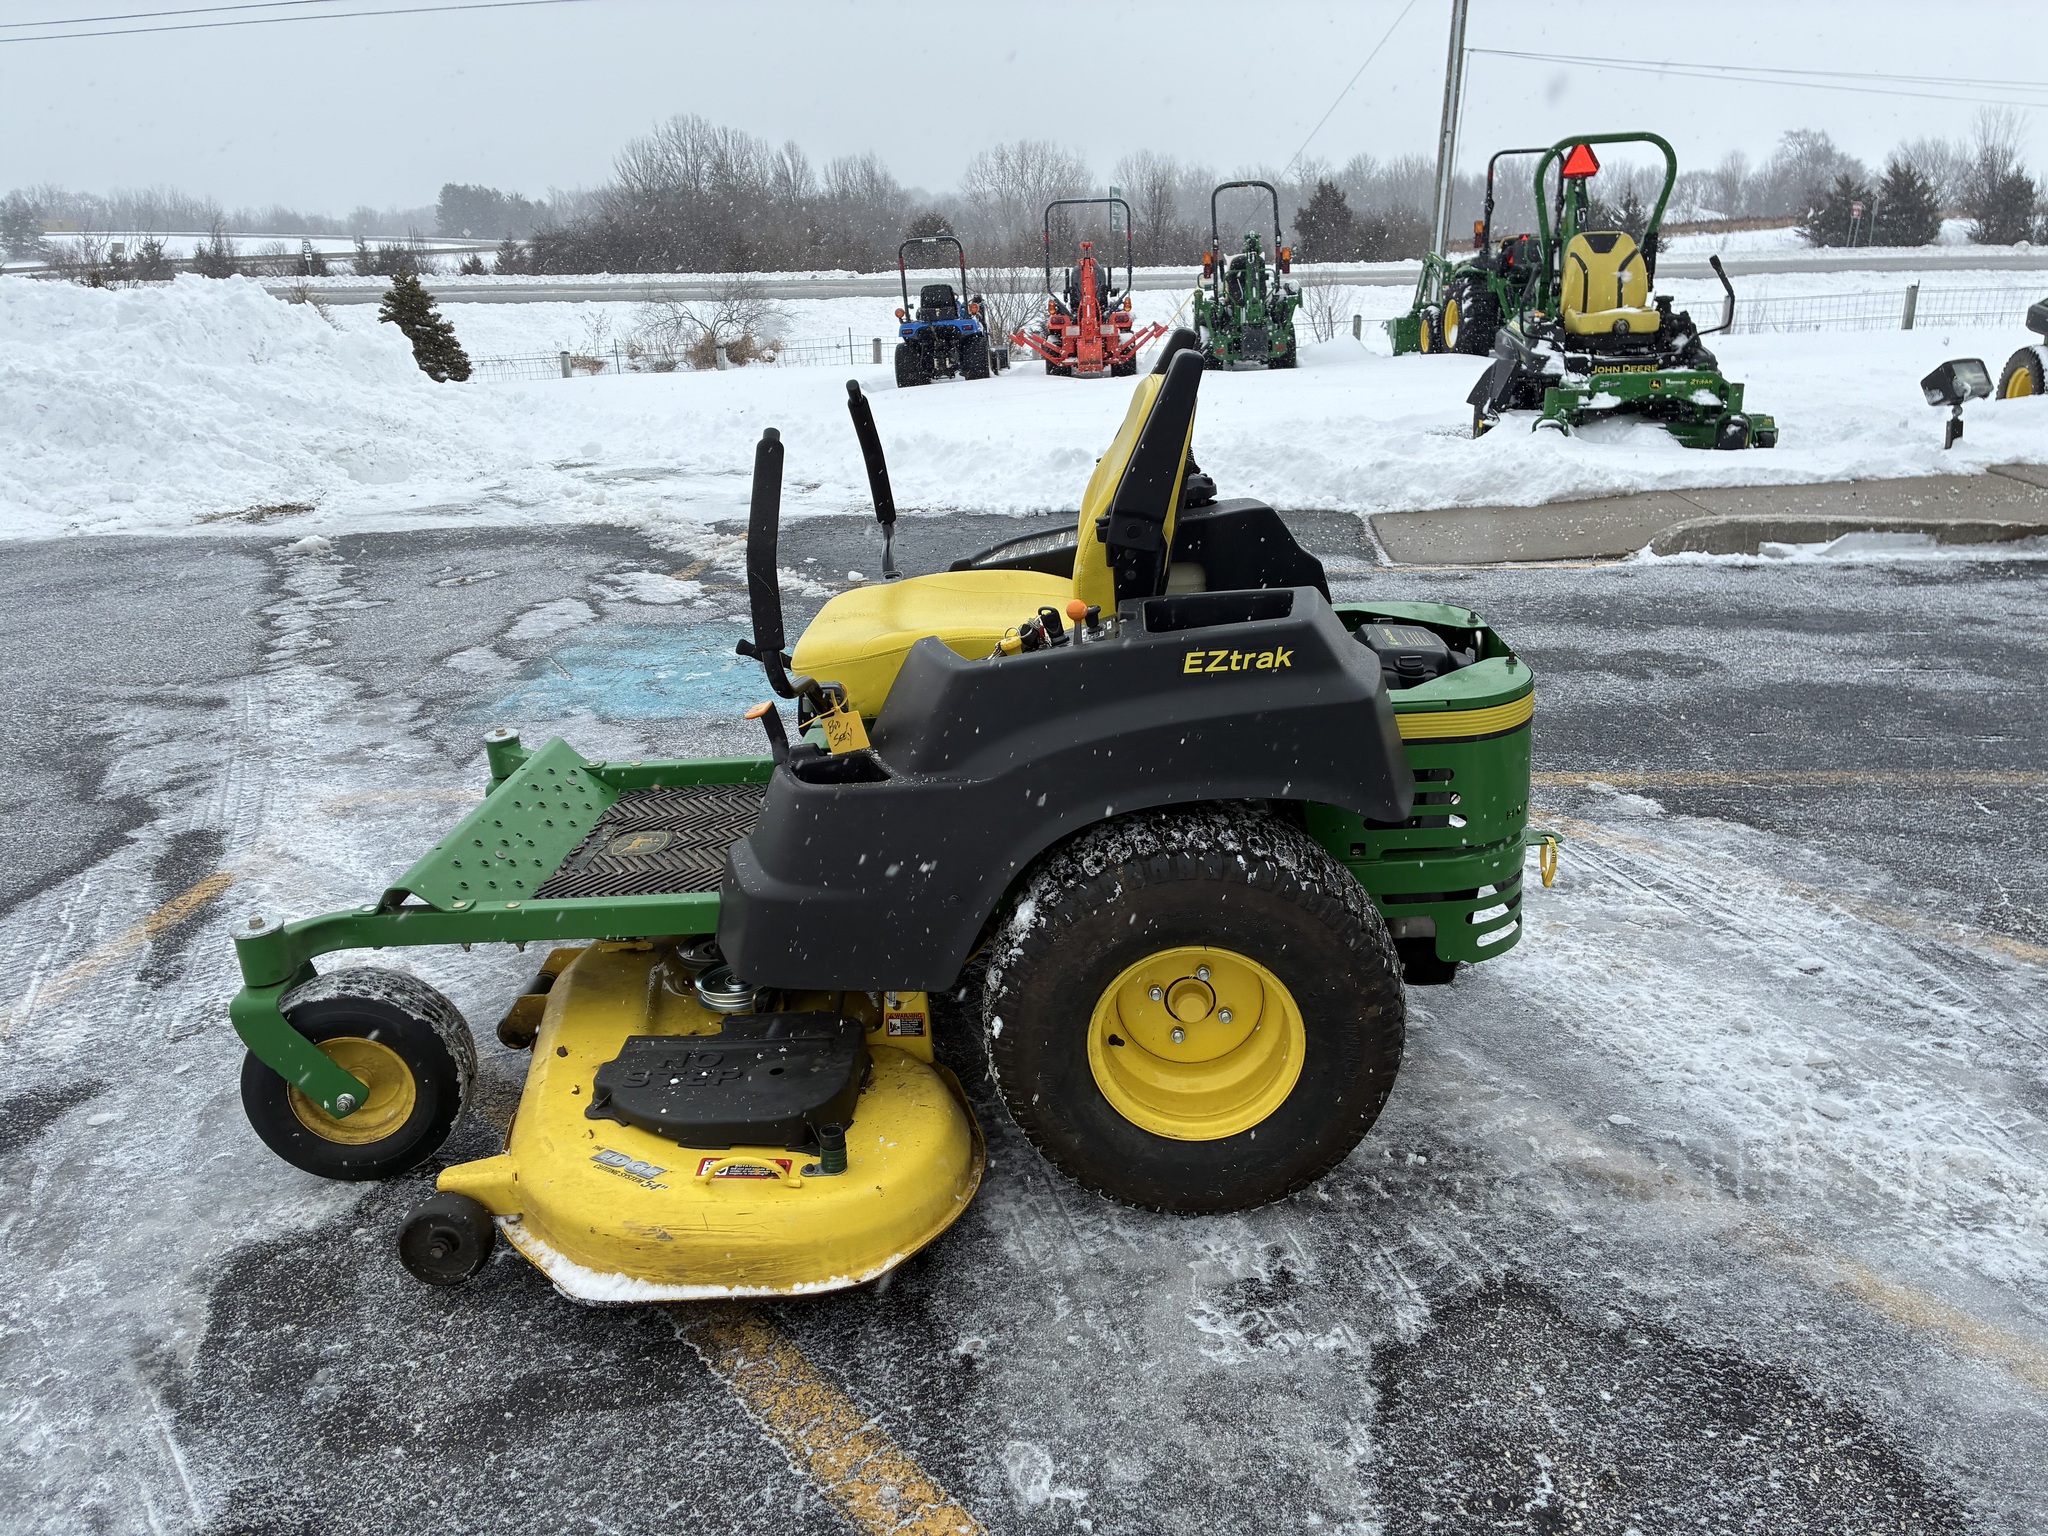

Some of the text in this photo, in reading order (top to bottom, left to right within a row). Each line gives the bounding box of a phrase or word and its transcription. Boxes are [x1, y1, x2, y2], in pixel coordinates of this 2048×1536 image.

[1591, 364, 1659, 374] JOHN DEERE
[1183, 646, 1294, 674] EZtrak
[660, 1050, 724, 1069] NO
[622, 1070, 744, 1089] STEP
[589, 1149, 668, 1180] EDGE
[593, 1163, 621, 1176] CUTTING
[617, 1172, 646, 1184] SYSTEM
